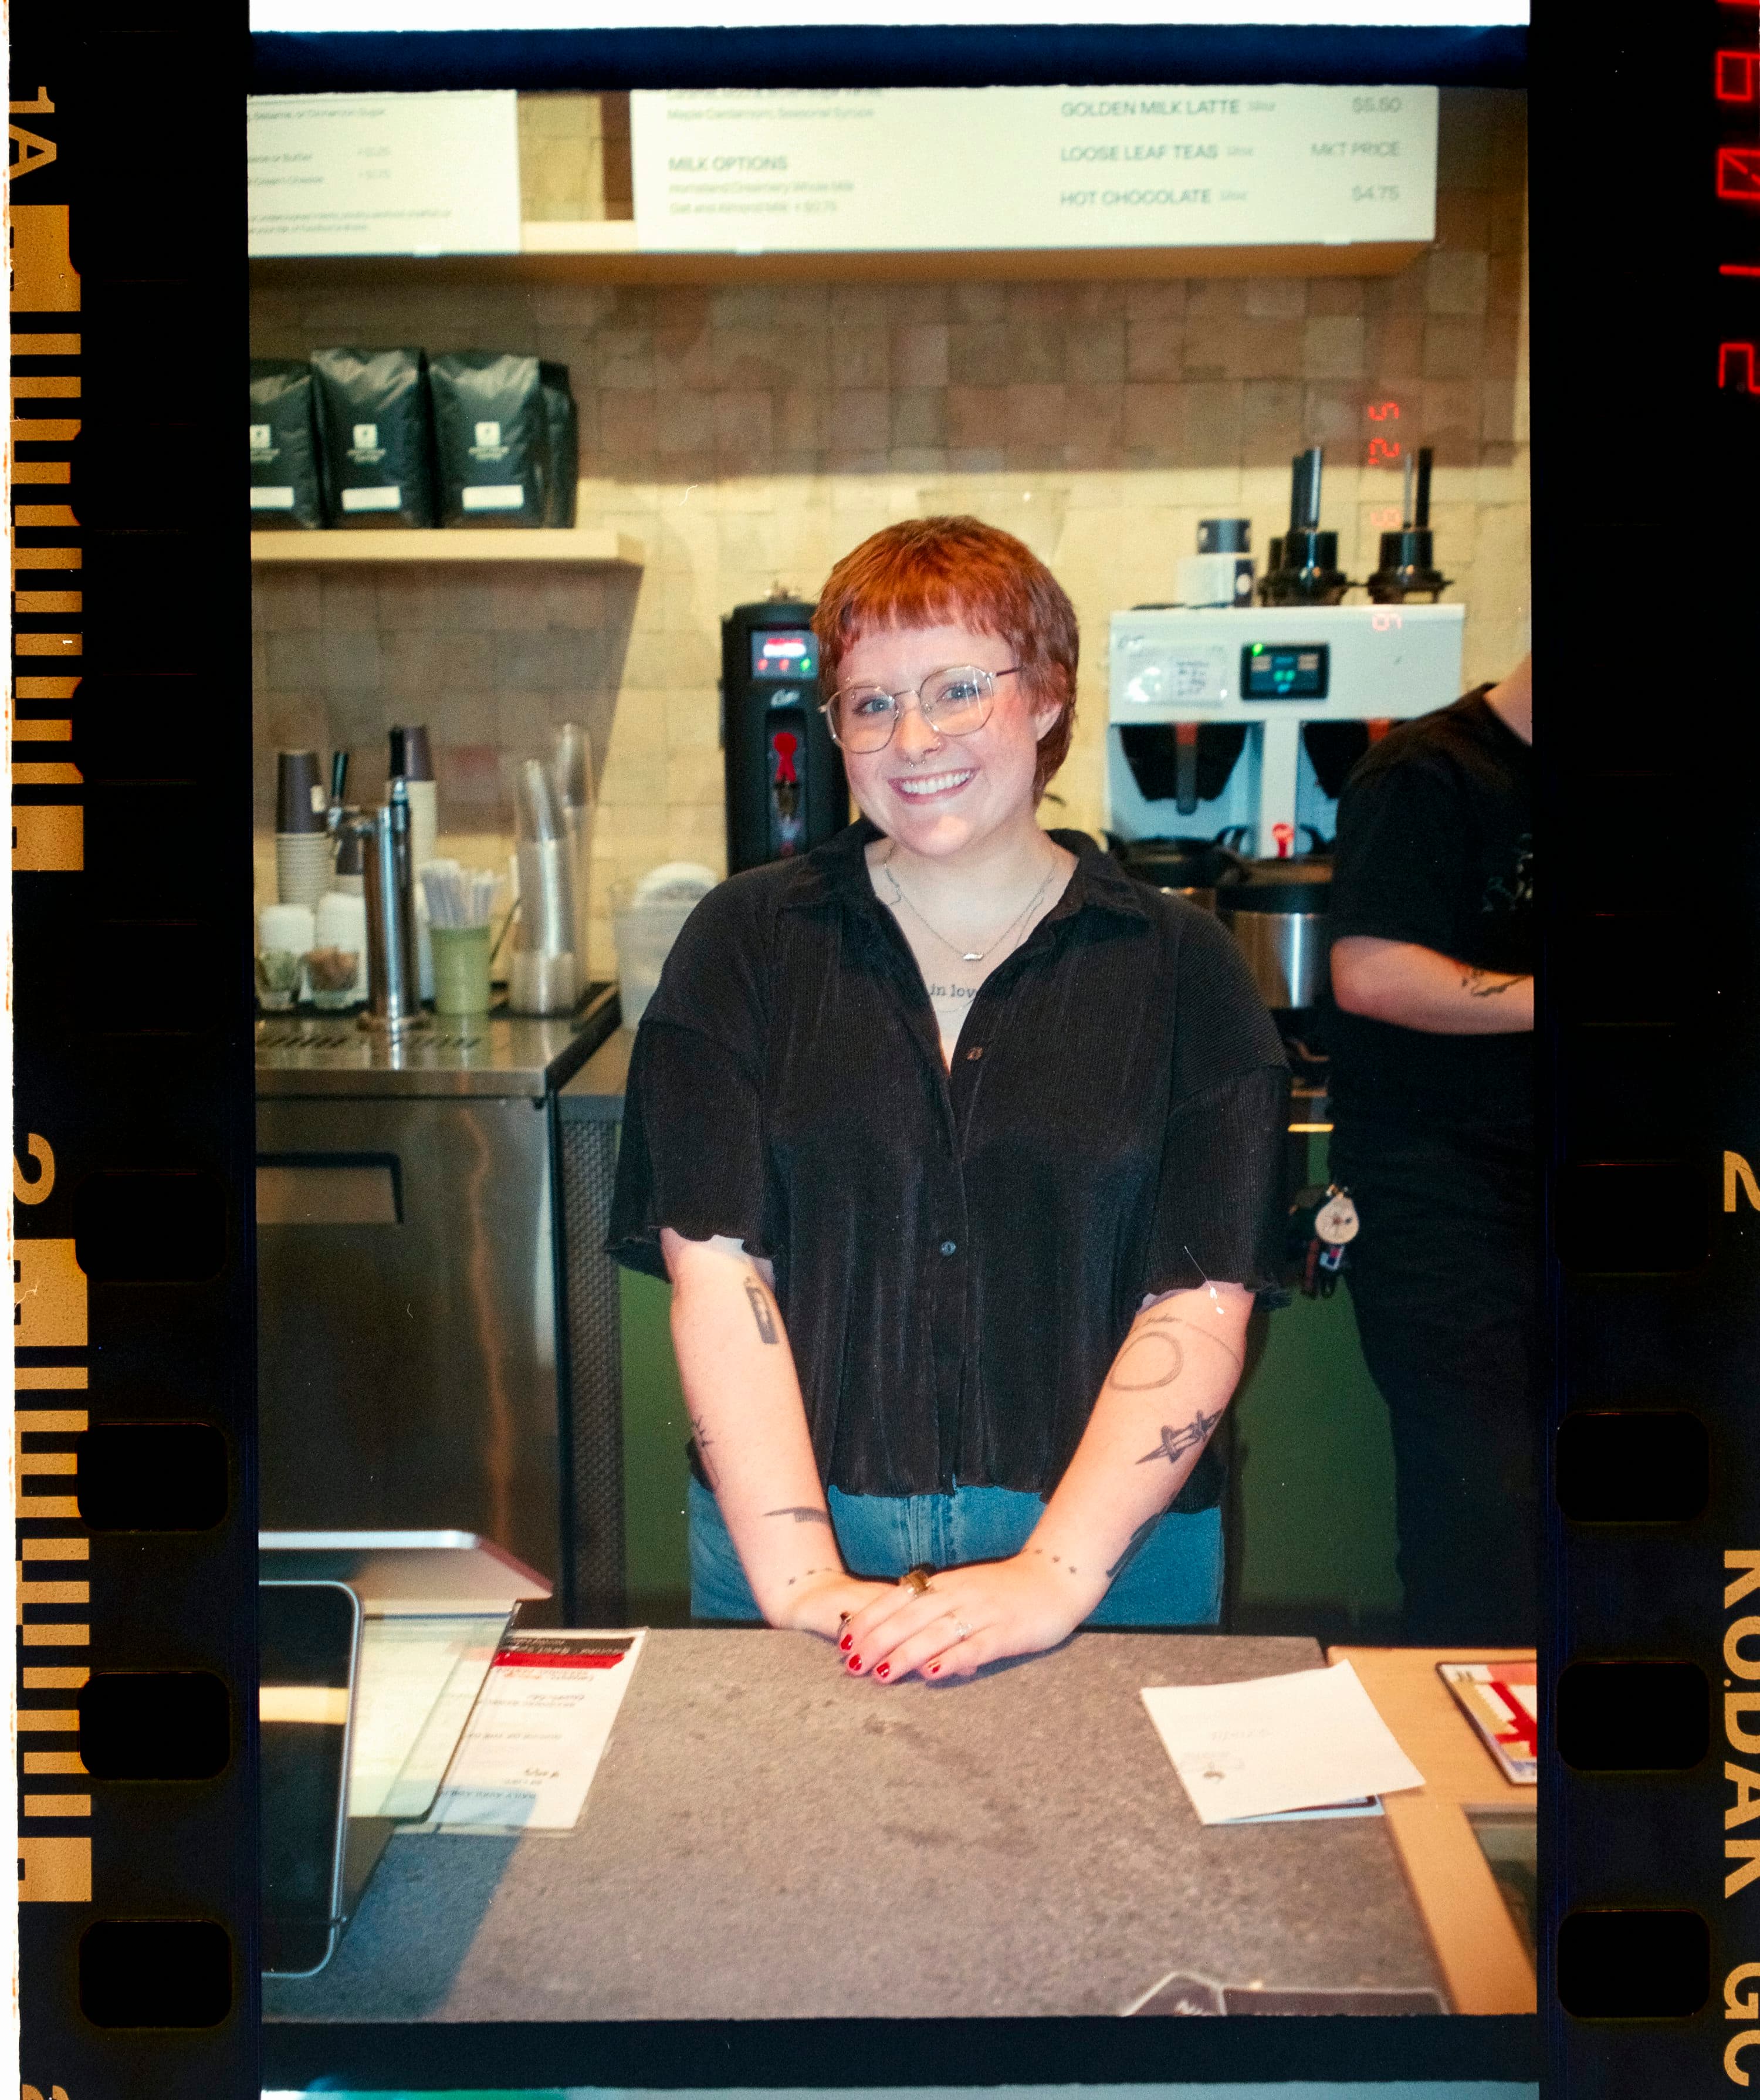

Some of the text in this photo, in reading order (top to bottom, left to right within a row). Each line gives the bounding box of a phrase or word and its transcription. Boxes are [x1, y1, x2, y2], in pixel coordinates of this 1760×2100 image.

[1061, 102, 1135, 117] GOLDEN
[1140, 100, 1182, 116] MILK
[1186, 99, 1240, 116] LATTE
[1061, 145, 1119, 161] LOOSE
[1124, 144, 1166, 160] LEAF
[1174, 143, 1219, 160] TEAS
[1351, 141, 1400, 157] PRICE
[668, 155, 788, 171] MILK OPTIONS
[1061, 190, 1096, 205] HOT
[1102, 189, 1211, 205] CHOCOLATE
[930, 984, 945, 996] in
